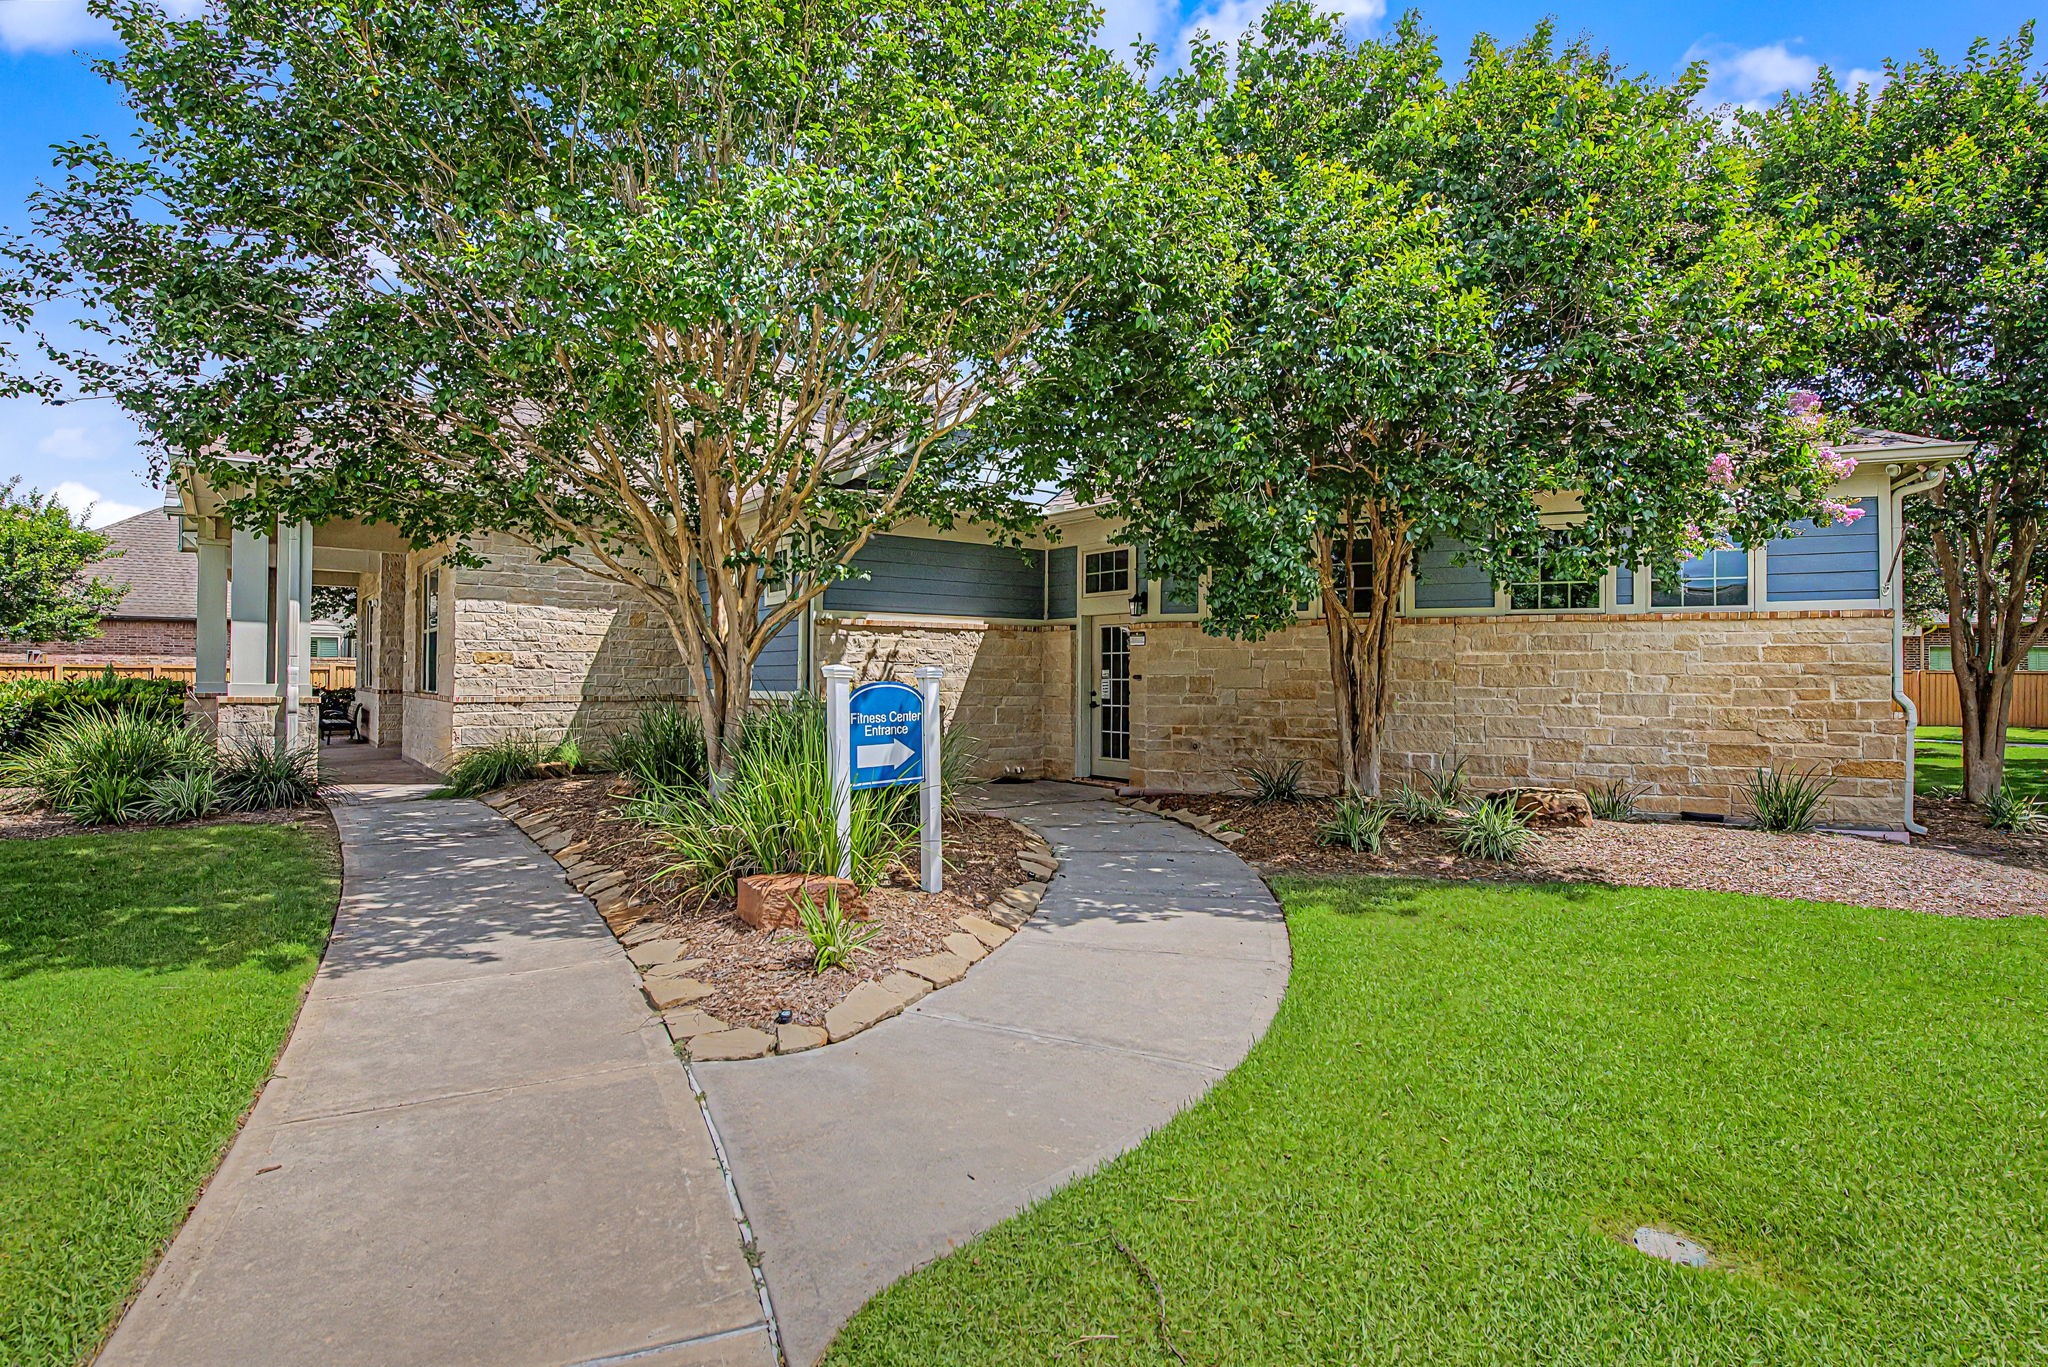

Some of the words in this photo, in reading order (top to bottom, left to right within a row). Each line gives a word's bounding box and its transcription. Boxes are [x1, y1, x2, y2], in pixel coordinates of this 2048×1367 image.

[851, 713, 887, 724] Fitness
[889, 711, 921, 722] Center
[865, 725, 908, 736] Entrance
